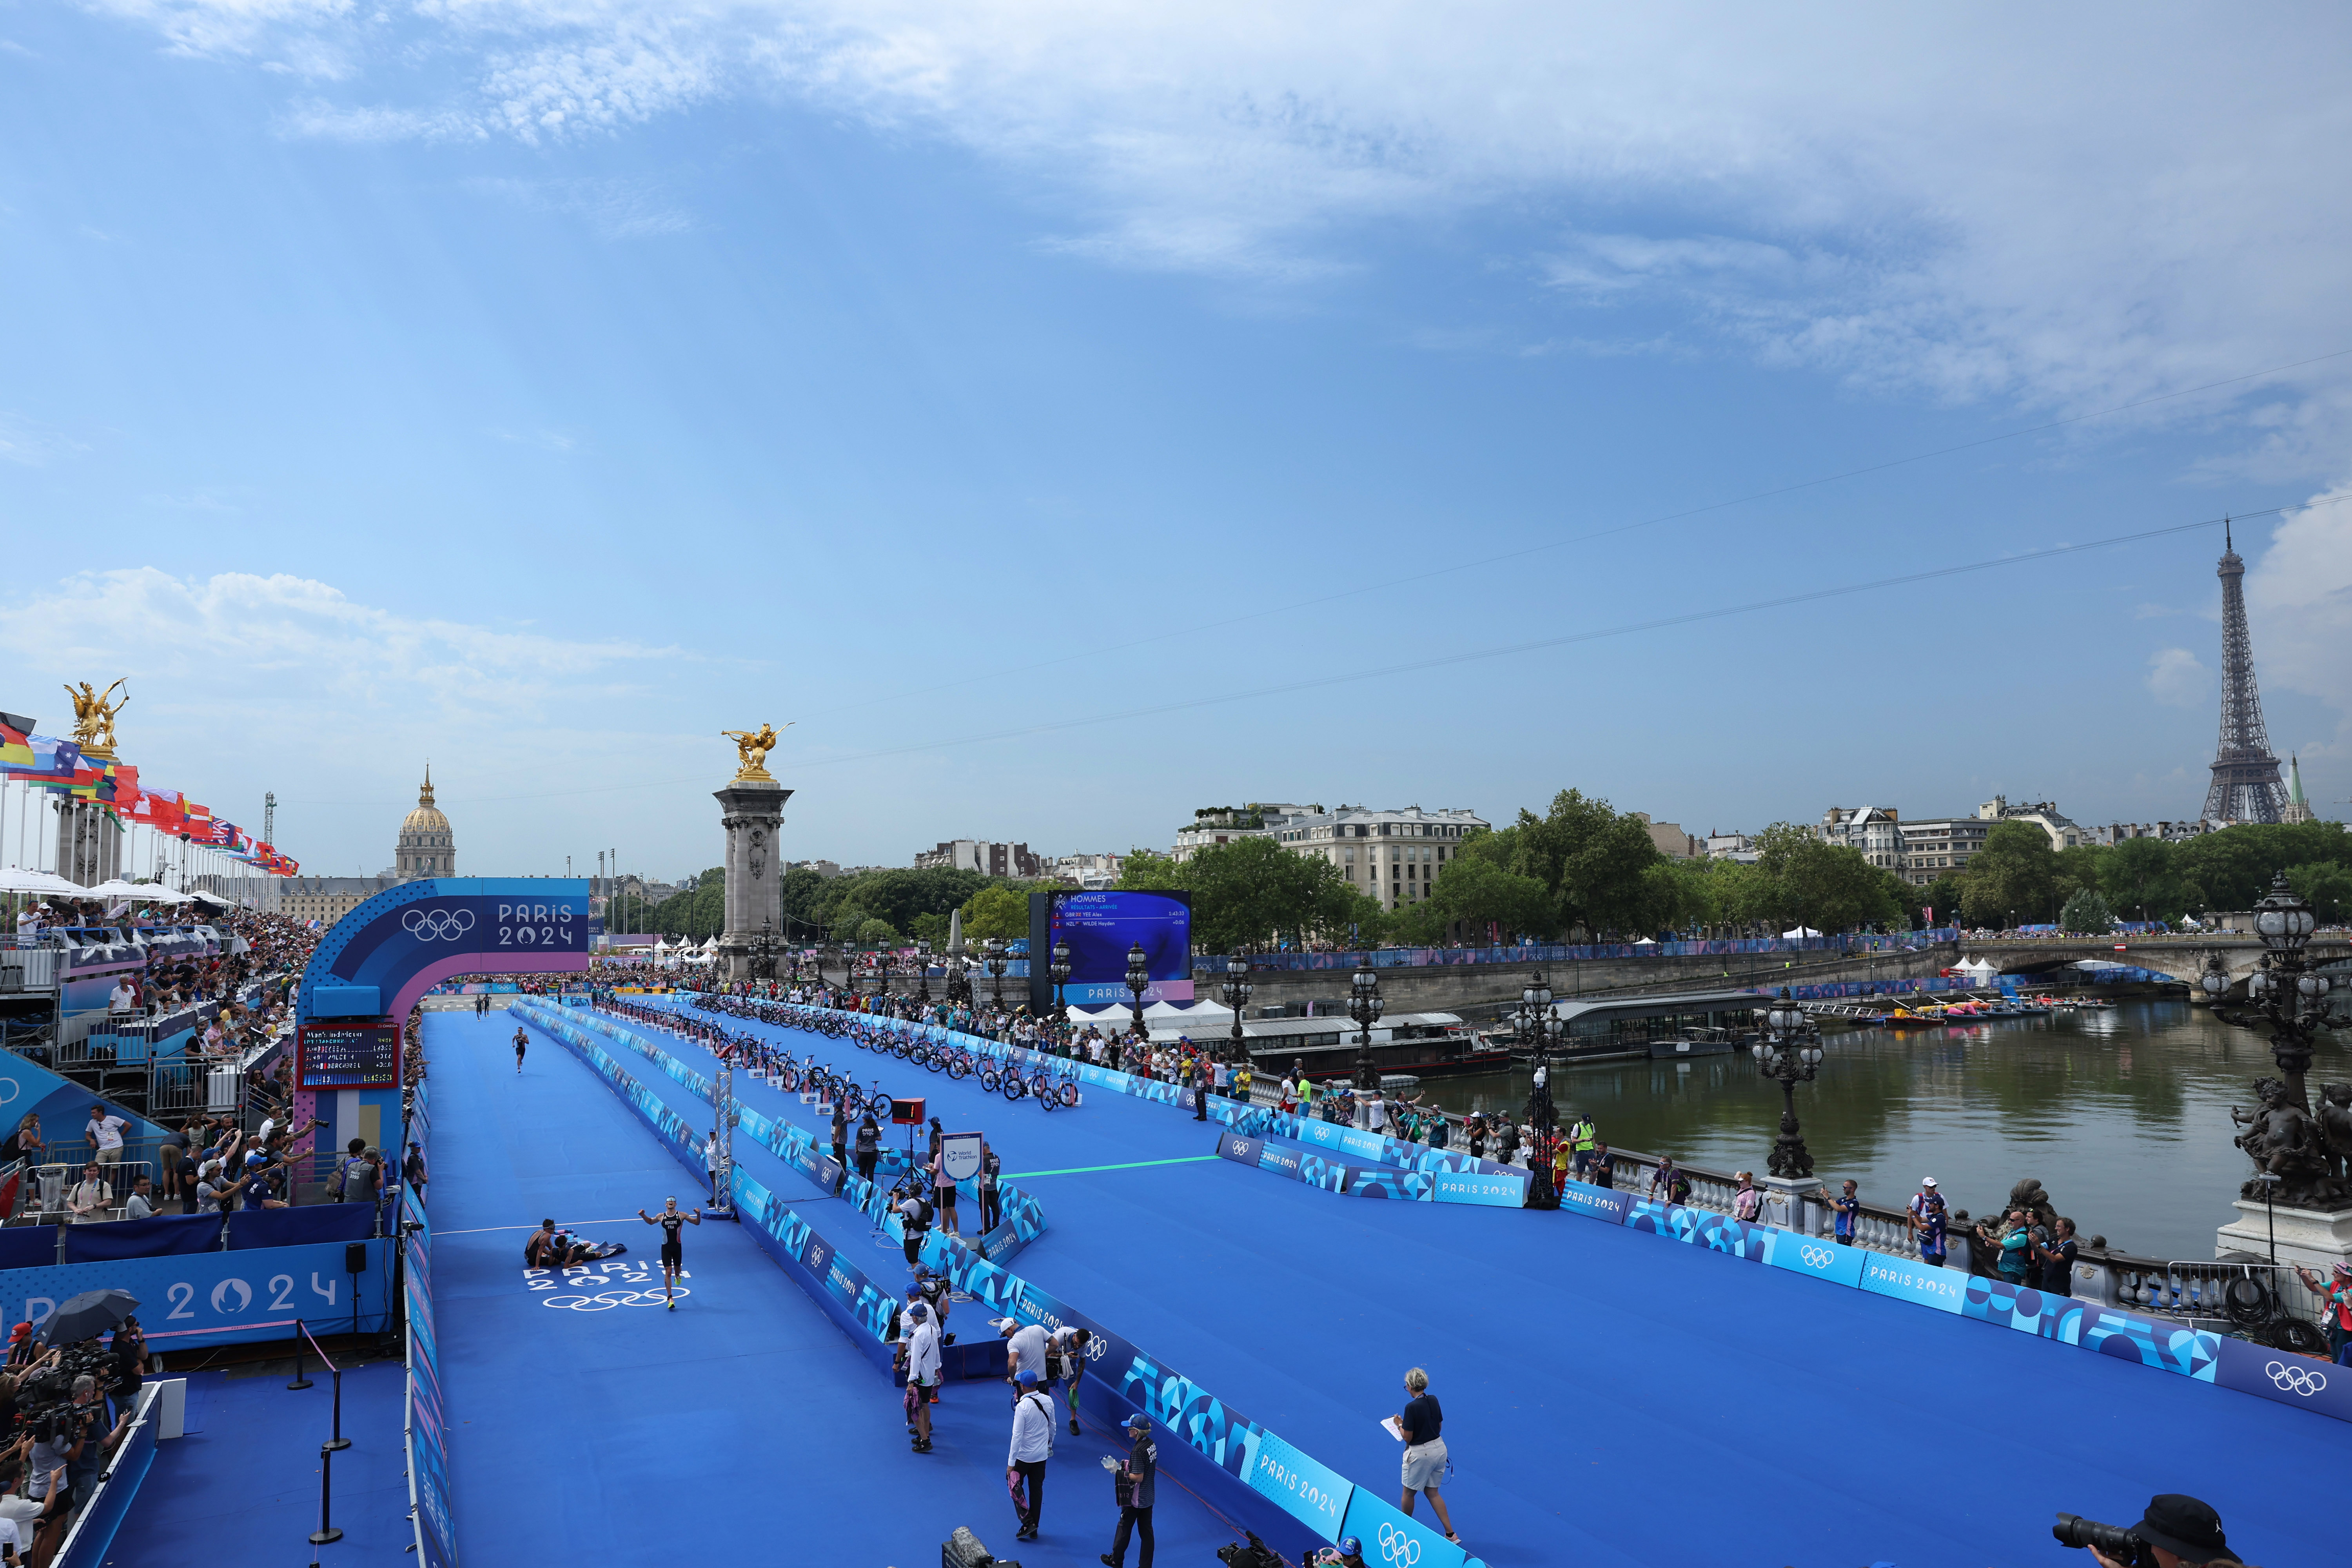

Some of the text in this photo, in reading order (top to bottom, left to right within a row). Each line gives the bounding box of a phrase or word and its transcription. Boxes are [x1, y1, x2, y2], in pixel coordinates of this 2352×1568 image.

[499, 904, 572, 922] PARIS
[498, 926, 572, 945] 2024
[1344, 1136, 1379, 1151] PARIS 2024
[1263, 1152, 1297, 1169] PARIS 2024
[1442, 1183, 1515, 1196] PARIS 2024
[1567, 1191, 1619, 1212] PARIS 2024
[989, 1232, 1016, 1259] PARIS 2024
[830, 1266, 856, 1296] PARIS 2024
[1871, 1267, 1956, 1297] PARIS 2024
[166, 1272, 336, 1319] 2024
[1260, 1454, 1336, 1517] PARIS 2024
